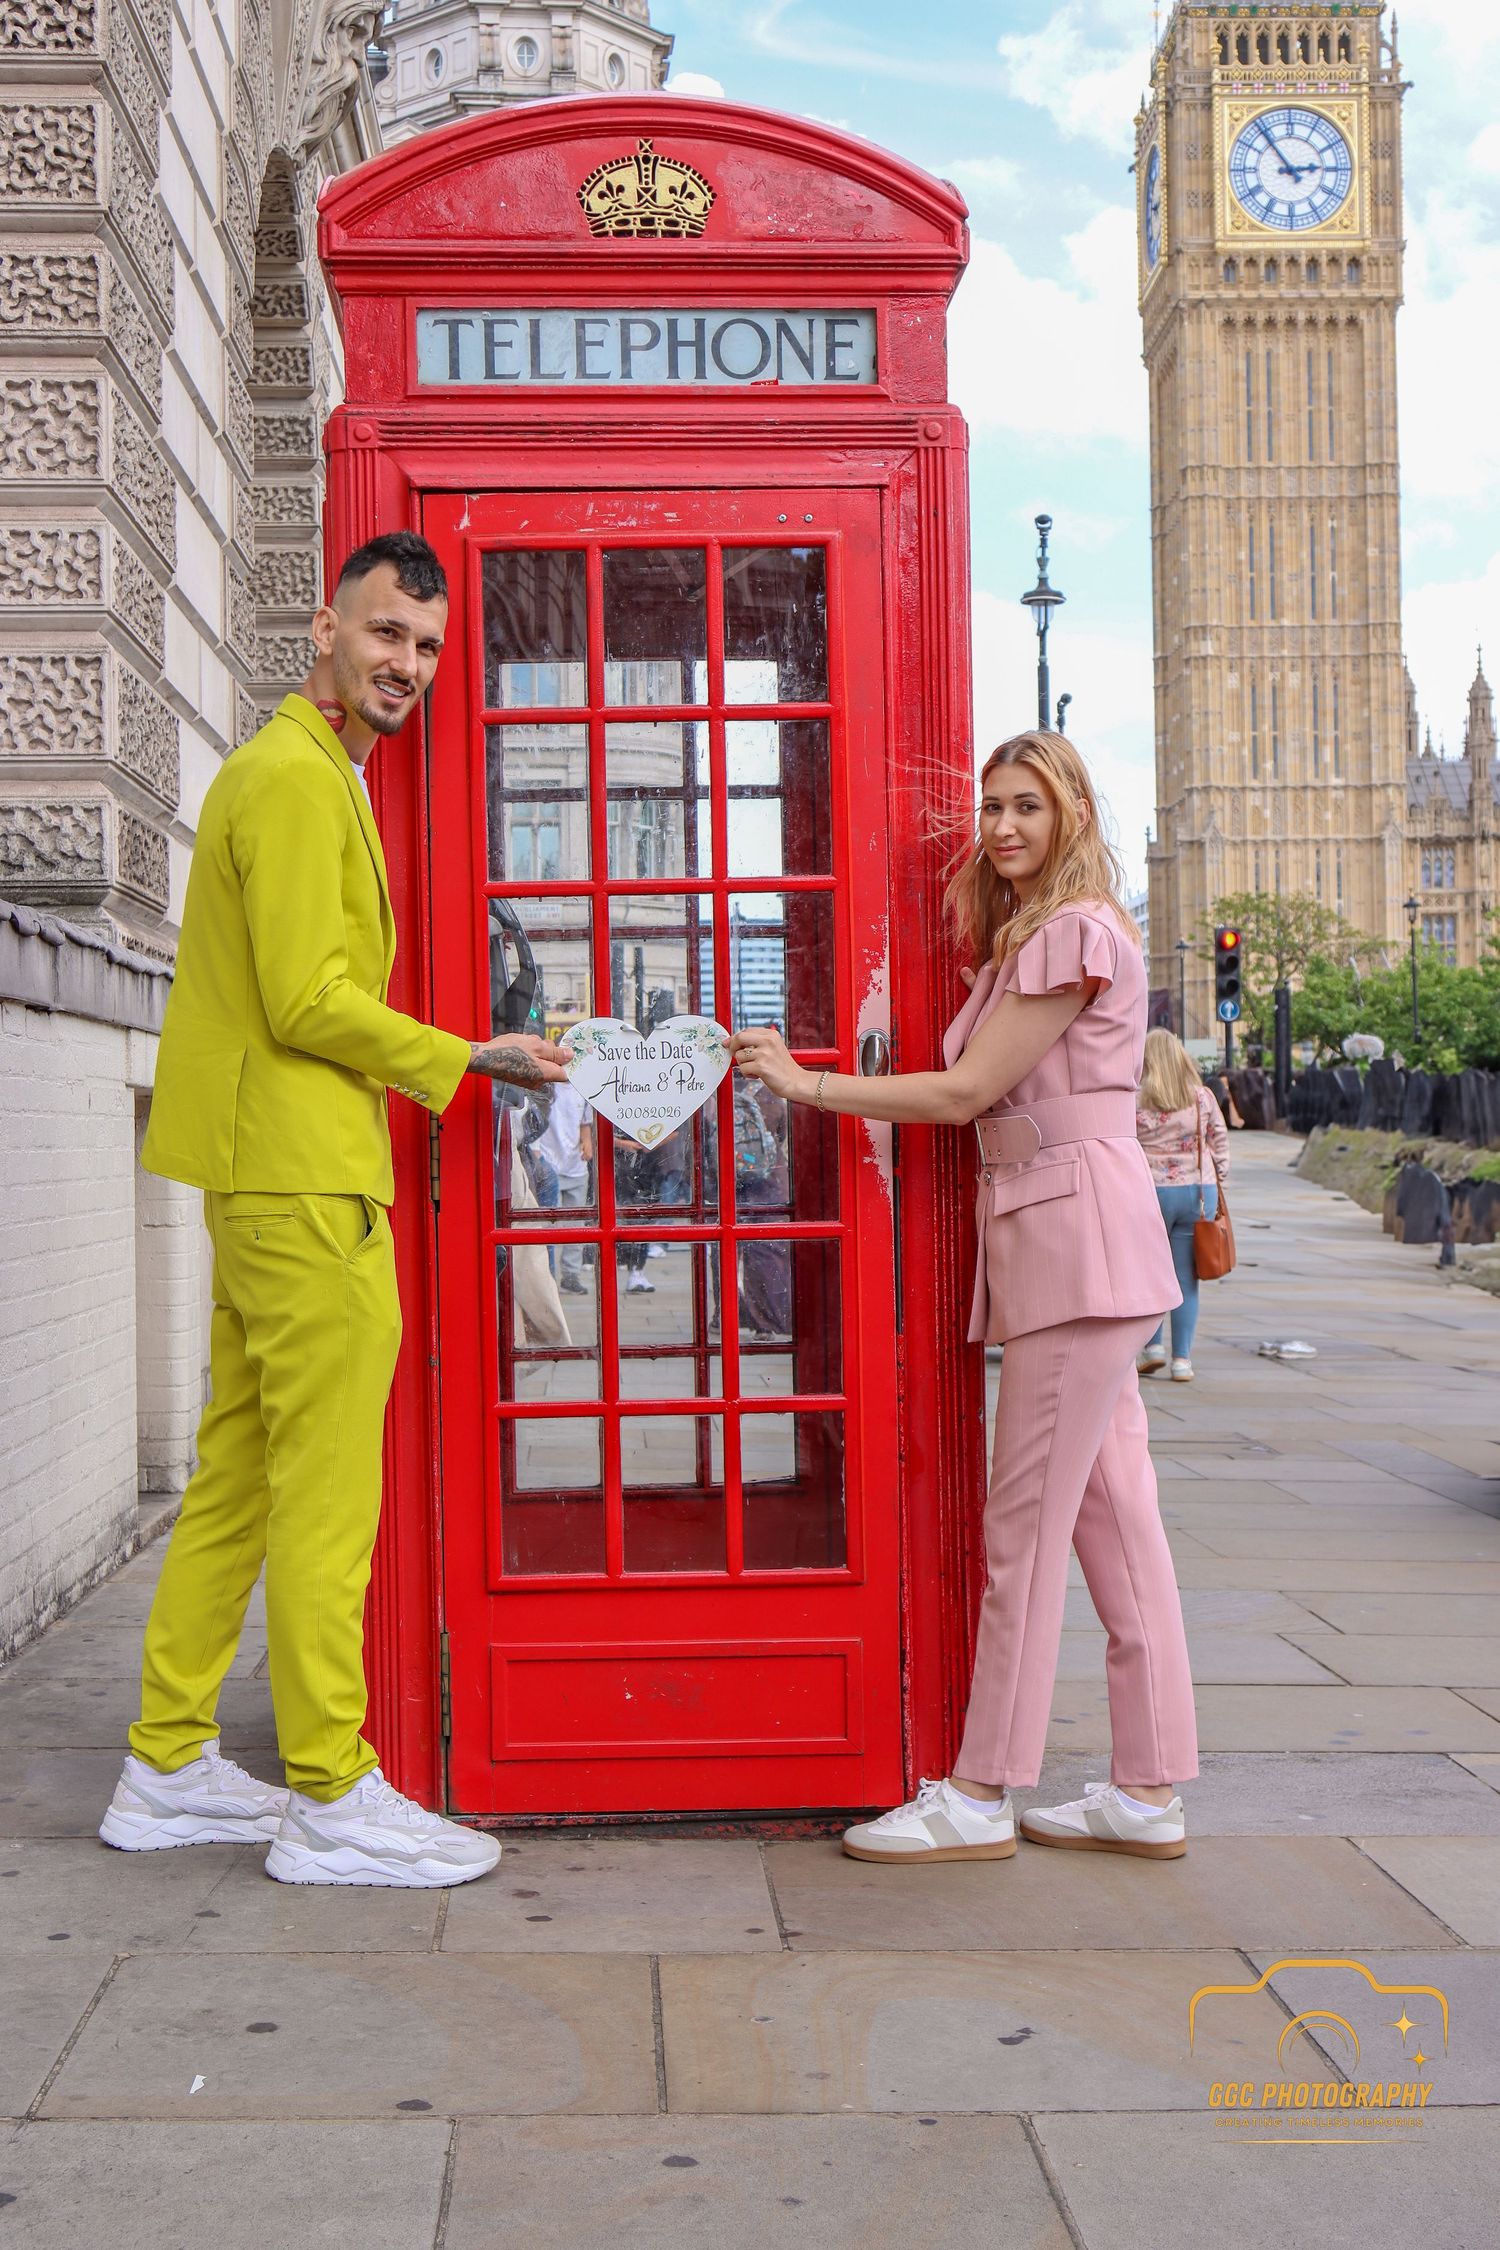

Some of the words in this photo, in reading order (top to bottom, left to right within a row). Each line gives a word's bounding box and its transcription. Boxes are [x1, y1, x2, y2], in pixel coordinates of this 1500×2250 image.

[432, 318, 861, 381] TELEPHONE
[597, 1042, 632, 1061] Save
[635, 1041, 657, 1060] the
[660, 1040, 693, 1060] Date
[588, 1065, 651, 1103] Adriana
[657, 1071, 669, 1092] &
[669, 1061, 705, 1094] Petre
[616, 1105, 681, 1120] 30082026
